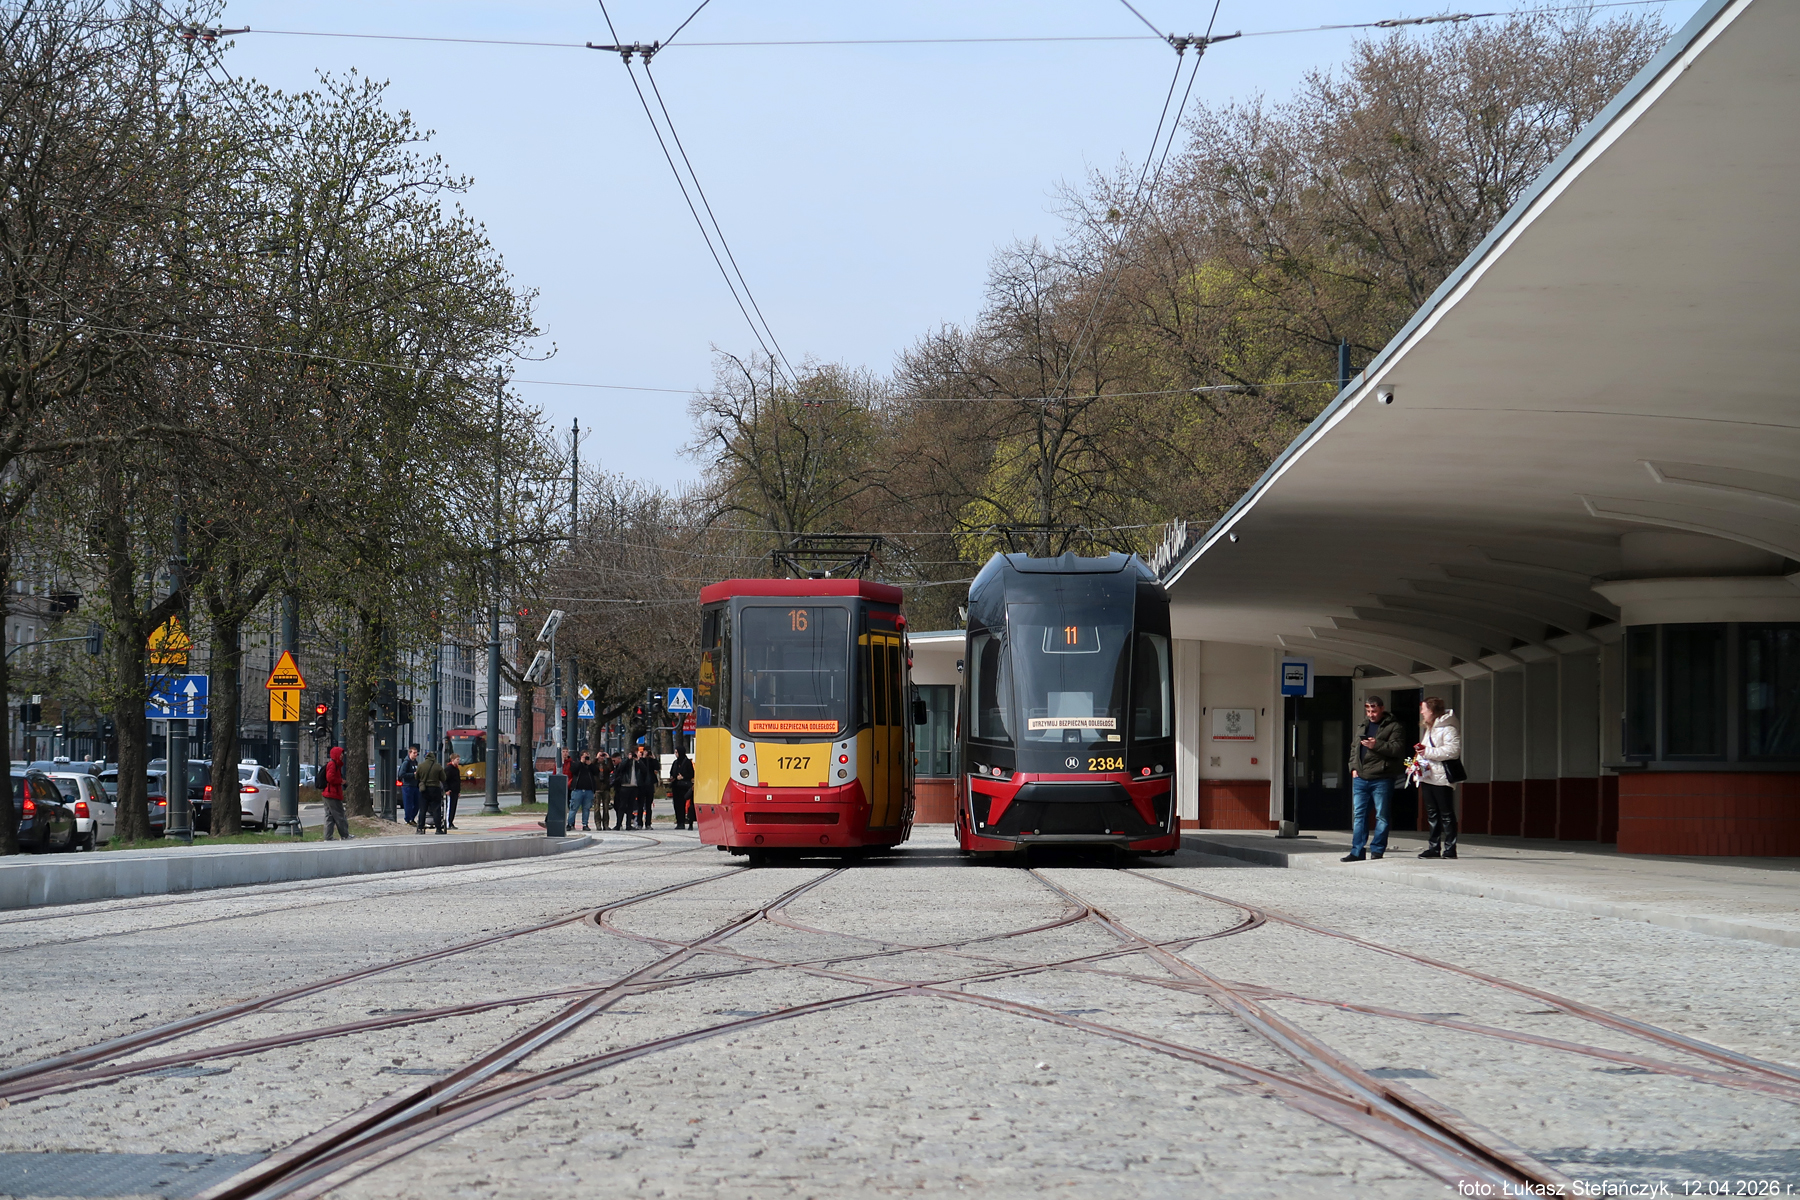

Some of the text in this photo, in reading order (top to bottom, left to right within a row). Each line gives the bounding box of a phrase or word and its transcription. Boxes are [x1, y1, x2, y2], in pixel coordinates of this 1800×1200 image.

[788, 609, 808, 631] 16
[1064, 625, 1077, 644] 11
[780, 723, 808, 731] BEZPIECZNĄ
[809, 721, 836, 730] ODLEGŁOŚĆ
[1032, 718, 1114, 728] UTRZYMUJ BEZPIECZNĄ ODLEGŁOŚĆ
[777, 757, 811, 770] 1727
[1088, 757, 1124, 770] 2384
